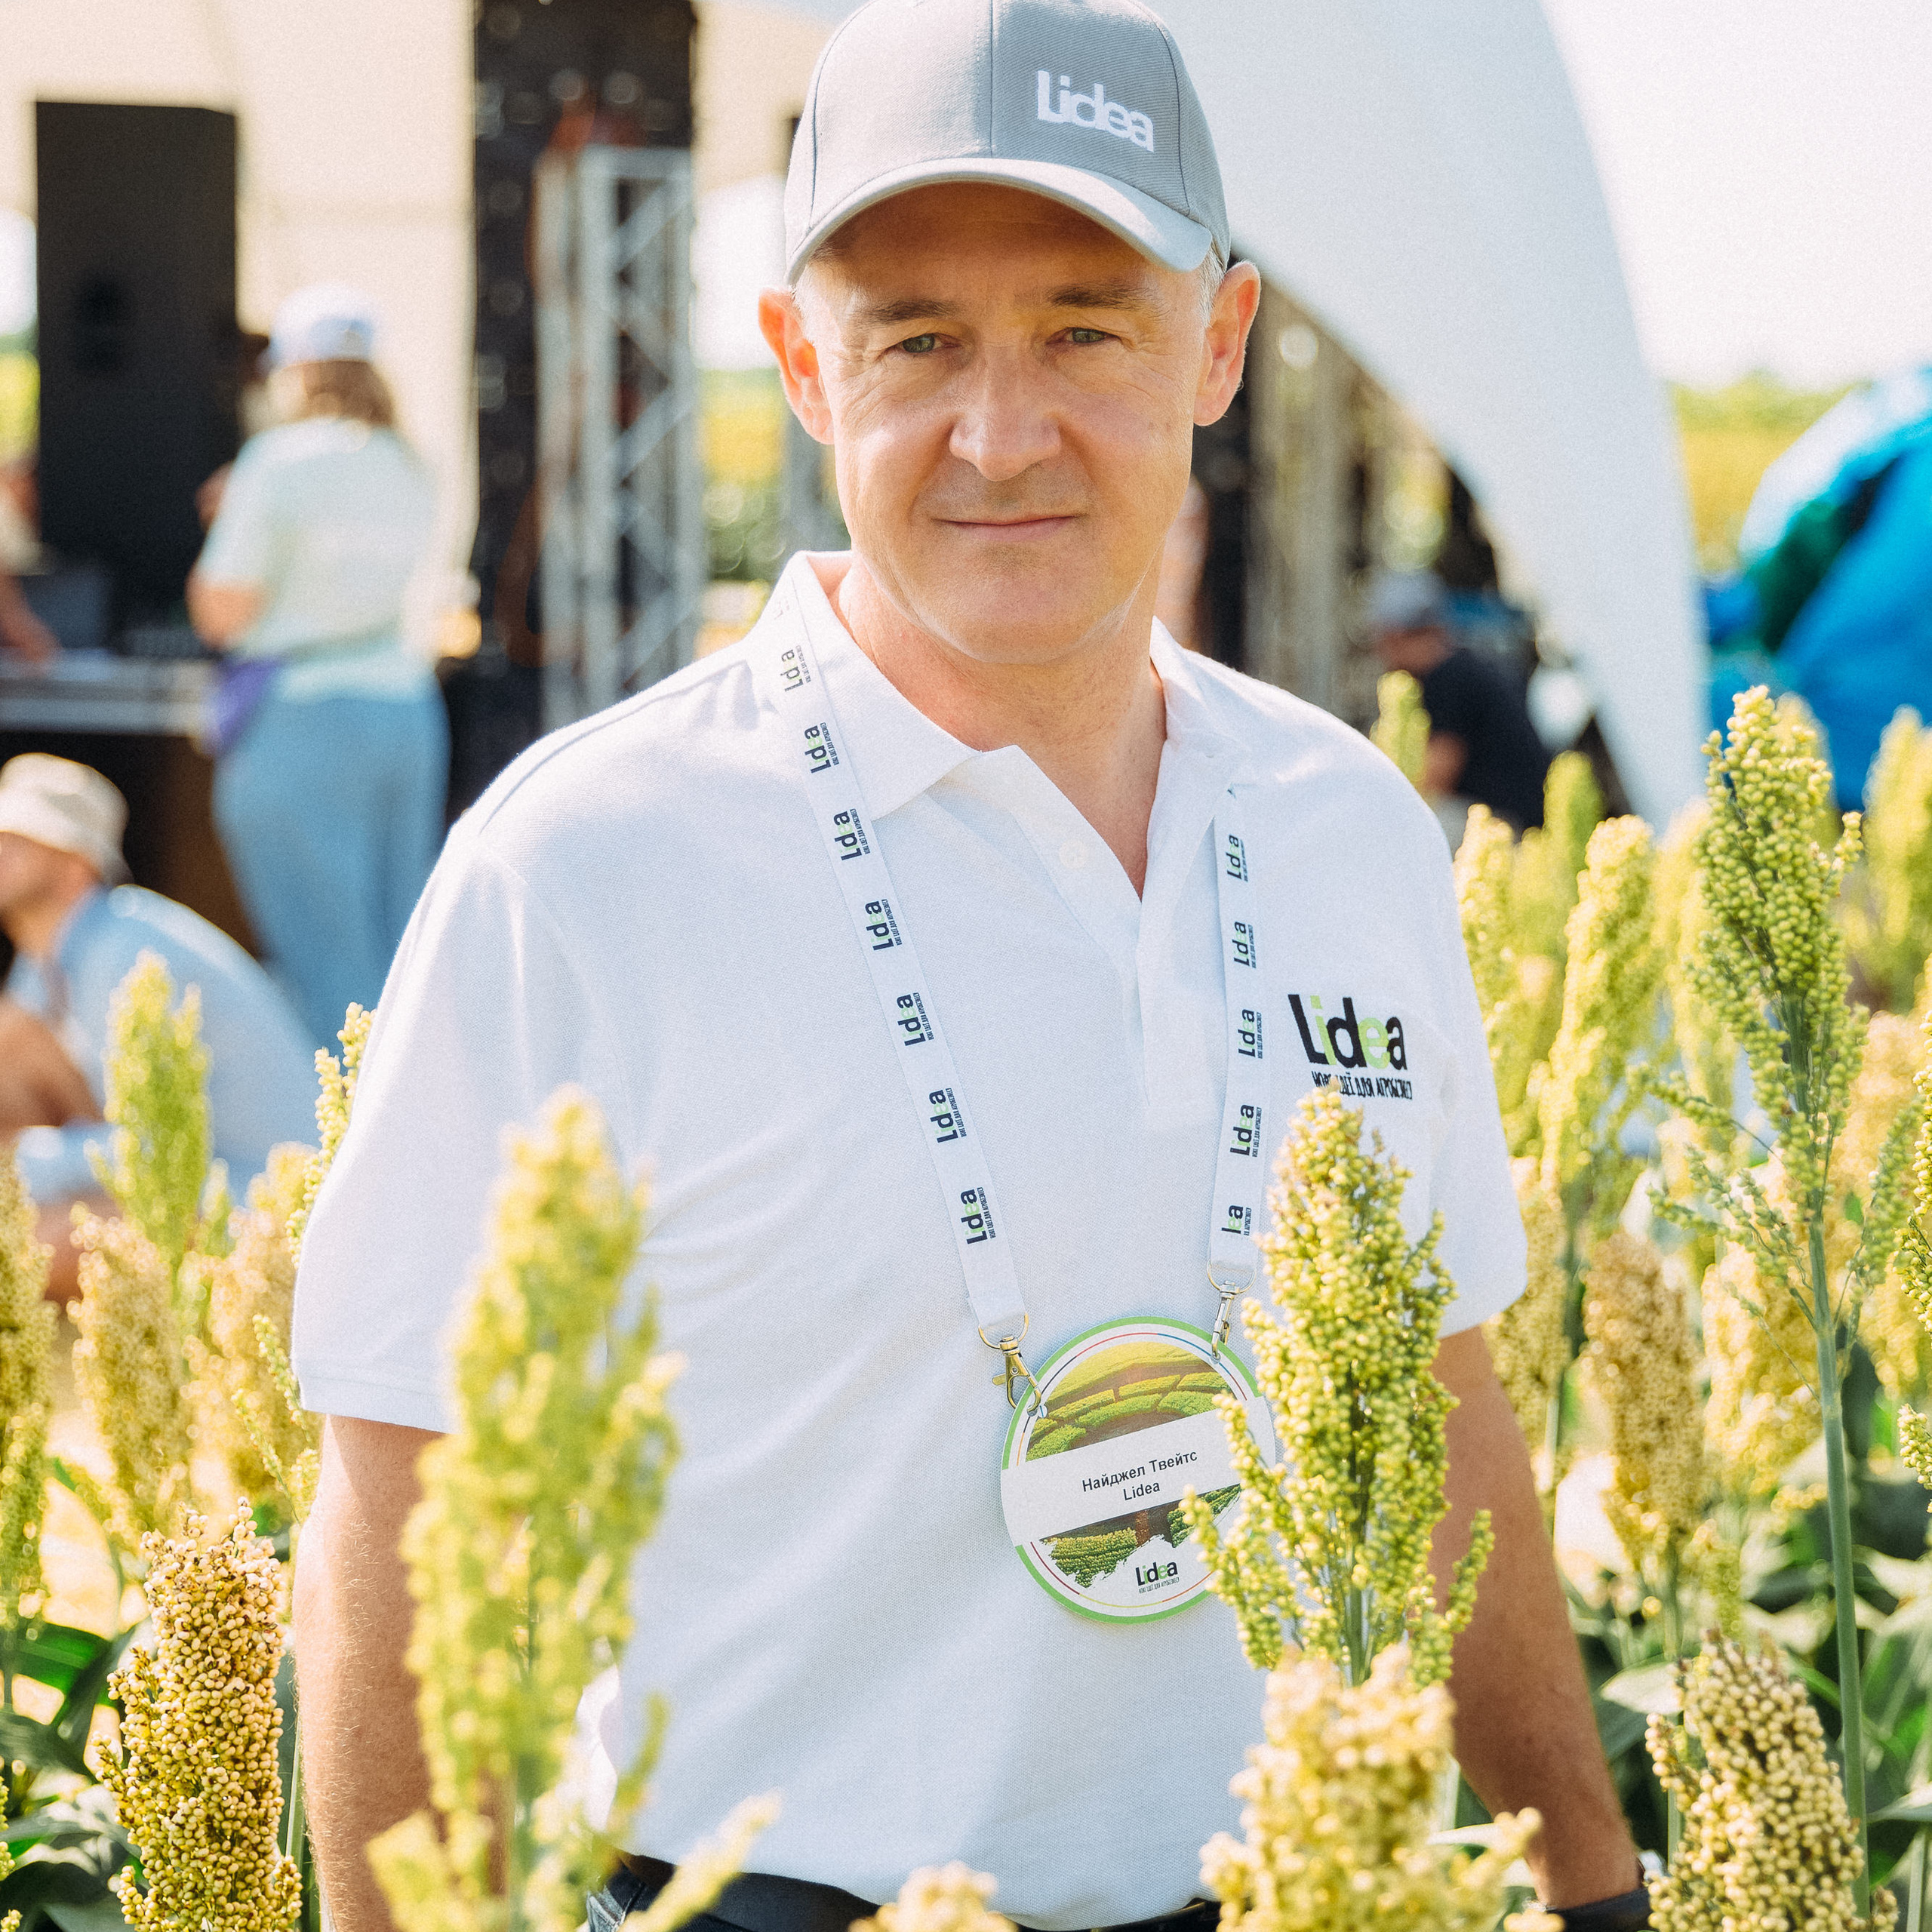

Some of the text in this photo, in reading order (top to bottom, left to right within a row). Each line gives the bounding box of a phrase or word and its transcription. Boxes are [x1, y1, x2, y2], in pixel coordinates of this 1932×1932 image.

[1038, 70, 1154, 152] Lidea
[804, 725, 831, 774] Lidea
[833, 811, 862, 860] Lidea
[1225, 834, 1241, 880] Lidea
[864, 900, 894, 951] Lidea
[1232, 921, 1250, 967] Lidea
[897, 994, 926, 1046] Lidea
[1237, 1009, 1256, 1058] Lidea
[1287, 994, 1407, 1071] Lidea
[928, 1089, 958, 1143] Lidea
[1230, 1104, 1254, 1156] Lidea
[960, 1189, 988, 1244] Lidea
[1082, 1451, 1198, 1492] Найджел Твейтс
[1123, 1482, 1160, 1500] Lidea
[1135, 1561, 1178, 1586] Lidea
